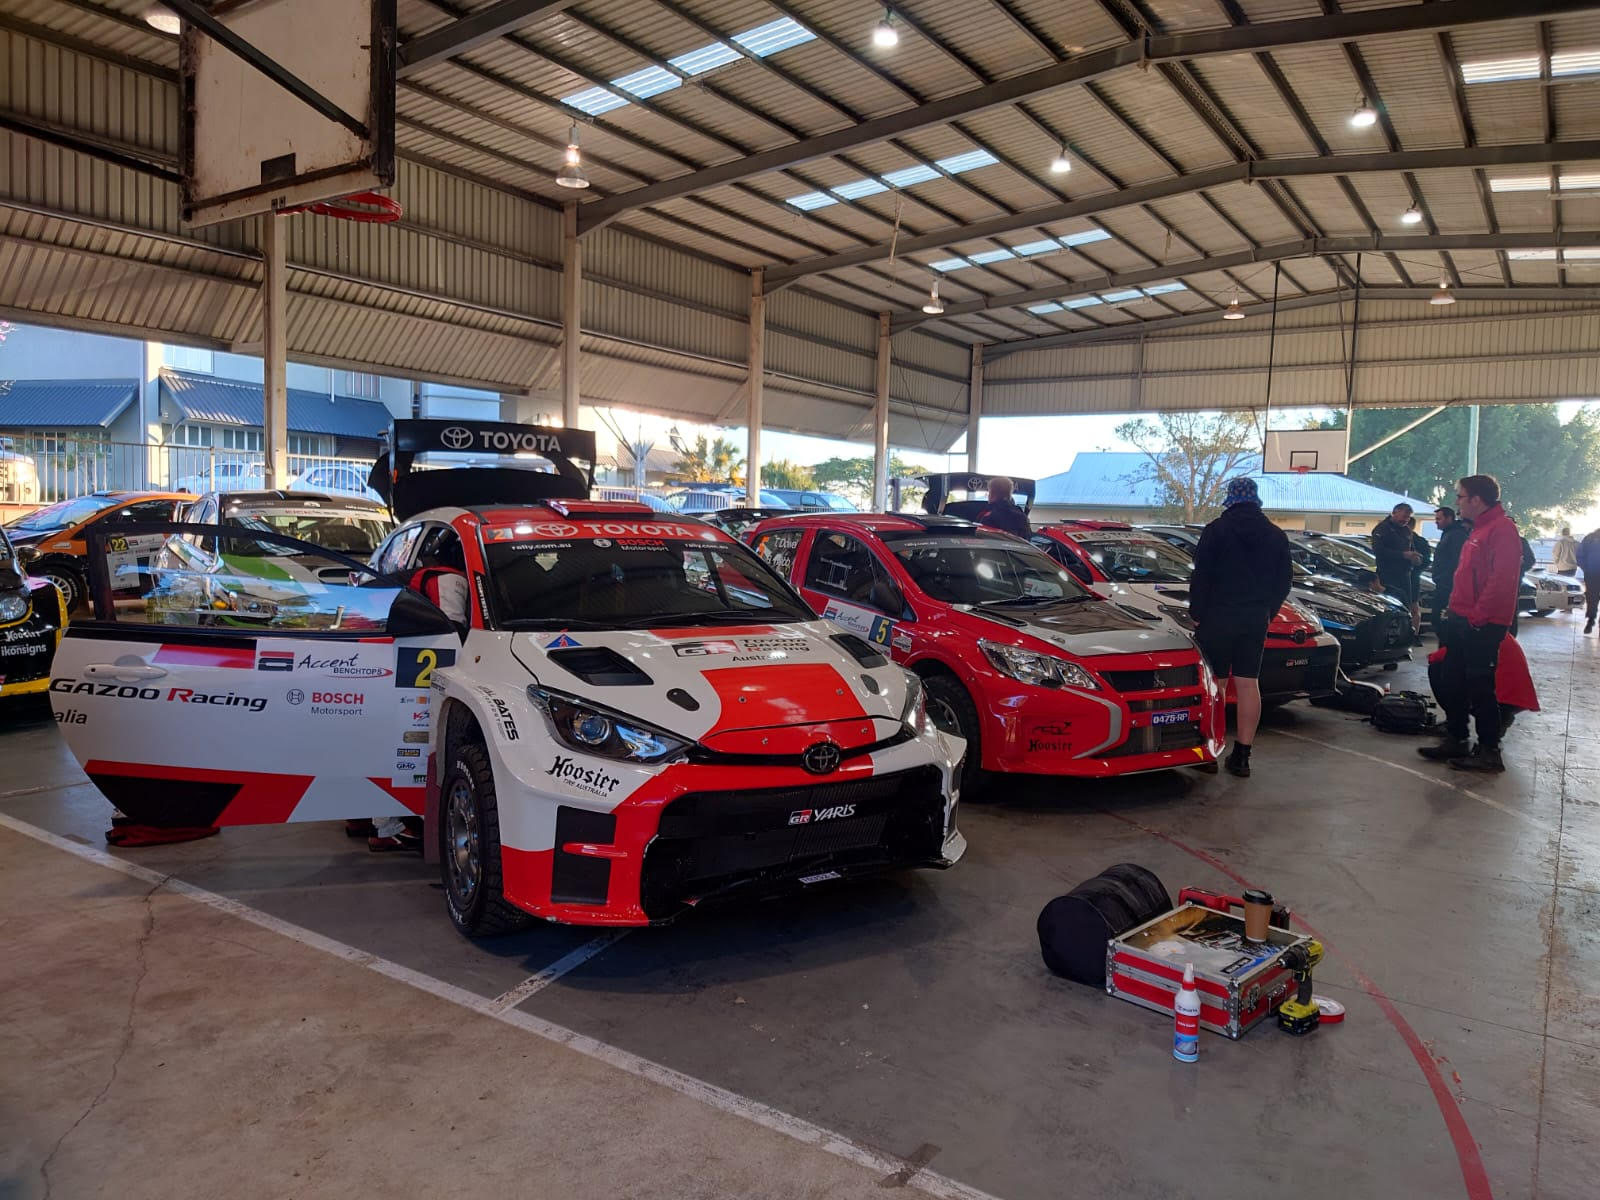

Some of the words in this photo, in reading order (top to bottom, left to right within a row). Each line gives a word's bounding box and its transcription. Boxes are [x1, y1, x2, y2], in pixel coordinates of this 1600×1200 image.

[479, 430, 562, 452] TOYOTA
[583, 523, 694, 538] TOYOTA
[111, 538, 127, 551] 22
[512, 543, 572, 551] rally.com.au
[616, 538, 664, 546] BOSCH
[876, 619, 890, 645] 5
[1, 643, 47, 657] ikonsigns
[297, 653, 359, 669] Accent
[415, 649, 437, 687] 2
[333, 667, 383, 676] BENCHTOPS
[50, 678, 160, 700] GAZOO
[166, 687, 268, 713] Racing
[311, 691, 365, 705] BOSCH
[310, 706, 363, 717] Motorsport
[492, 698, 520, 741] BATES
[545, 755, 620, 792] Hoosier
